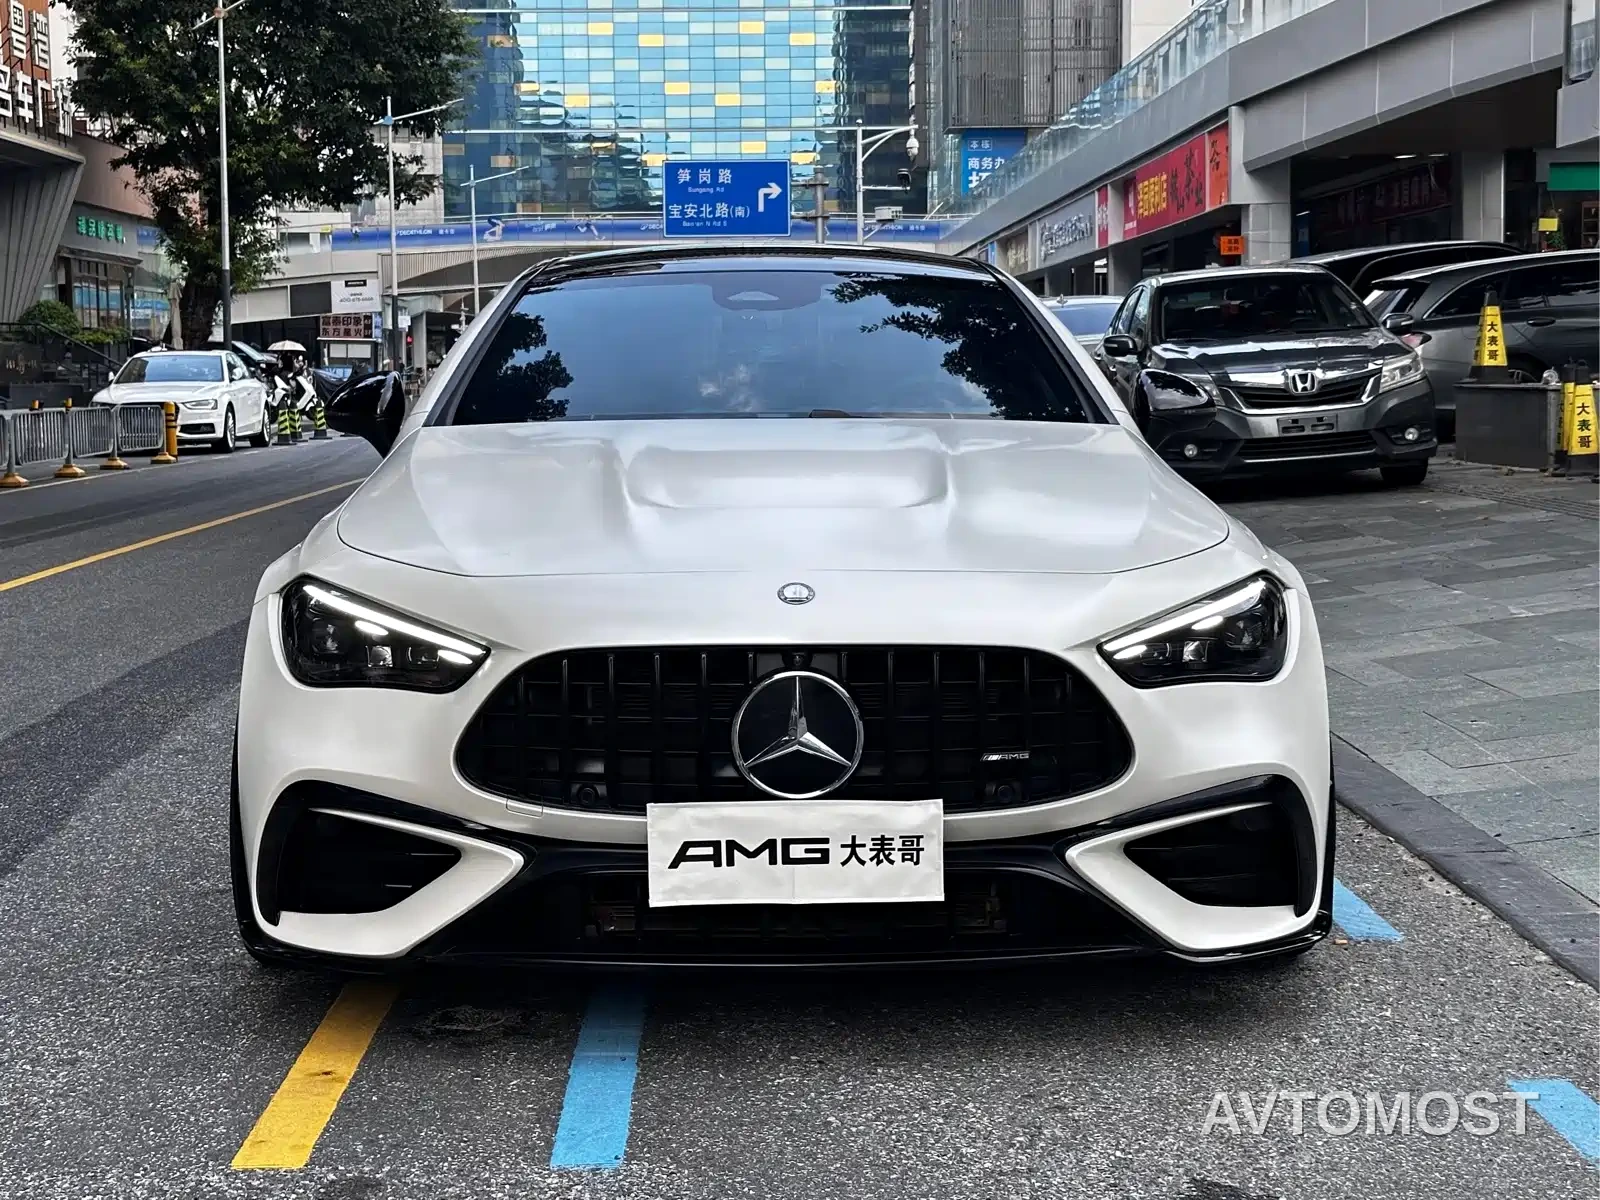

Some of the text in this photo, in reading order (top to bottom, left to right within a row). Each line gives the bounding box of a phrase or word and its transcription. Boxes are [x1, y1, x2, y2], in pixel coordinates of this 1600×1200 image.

[677, 168, 732, 184] 笋岗路
[668, 203, 750, 219] 宝安北路(南)
[1487, 321, 1500, 361] 大表哥
[1576, 402, 1592, 448] 大表哥
[668, 835, 924, 869] AMG 大表哥
